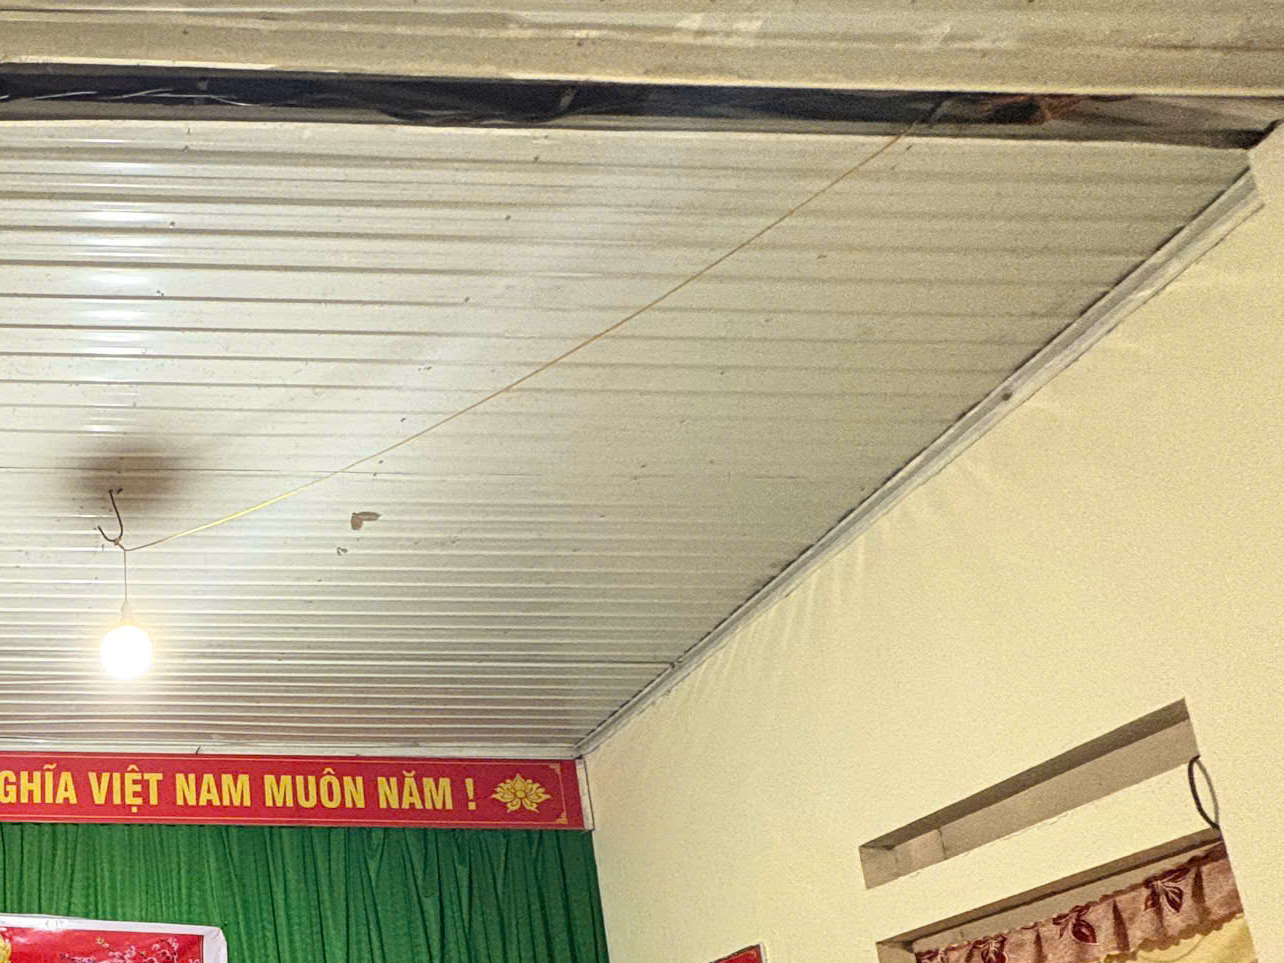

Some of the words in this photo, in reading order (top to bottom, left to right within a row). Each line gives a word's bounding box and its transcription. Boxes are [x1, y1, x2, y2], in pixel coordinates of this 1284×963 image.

[88, 764, 163, 812] VIỆT
[175, 773, 251, 808] NAM
[264, 767, 365, 810] MUÔN
[377, 769, 454, 811] NĂM
